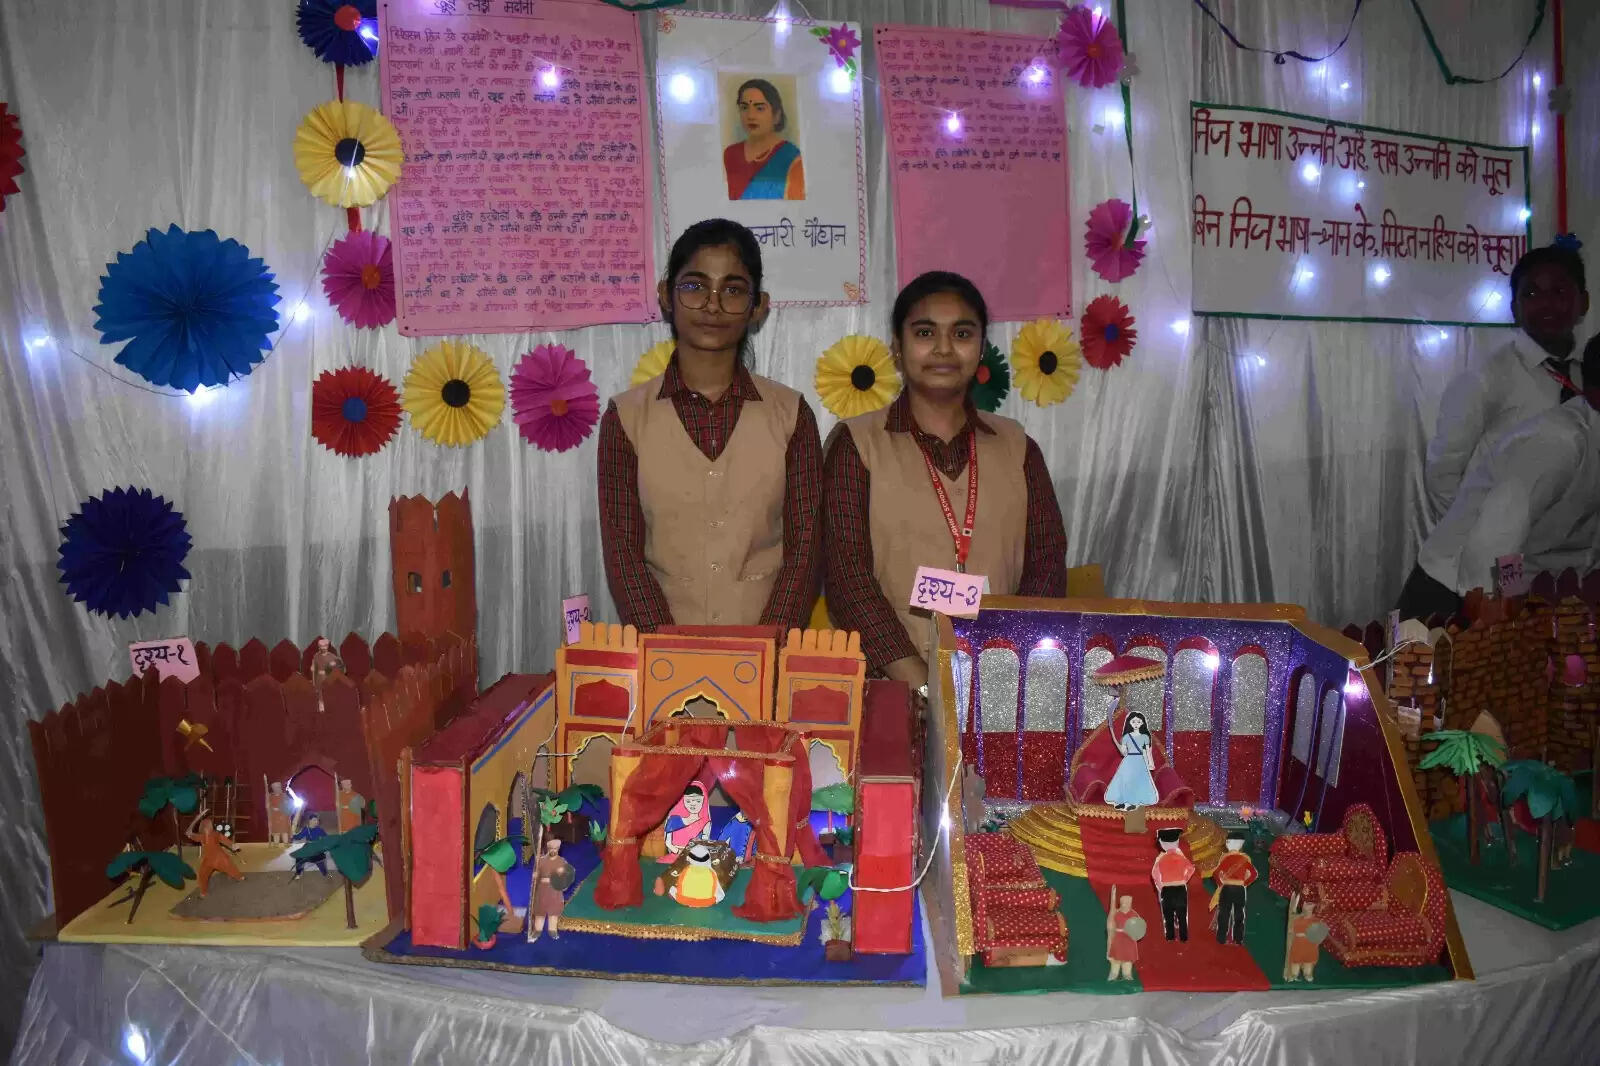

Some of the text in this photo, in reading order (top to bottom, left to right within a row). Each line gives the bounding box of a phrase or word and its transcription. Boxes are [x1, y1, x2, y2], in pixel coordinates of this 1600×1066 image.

[1193, 108, 1234, 157] निज
[1237, 121, 1283, 160] भाषा
[1286, 124, 1336, 168] उन्नति
[1371, 139, 1399, 176] सब
[1401, 141, 1451, 181] उन्नति
[1456, 146, 1479, 184] को
[748, 217, 795, 247] मारी
[1230, 196, 1276, 251] निज
[1458, 223, 1480, 264] को
